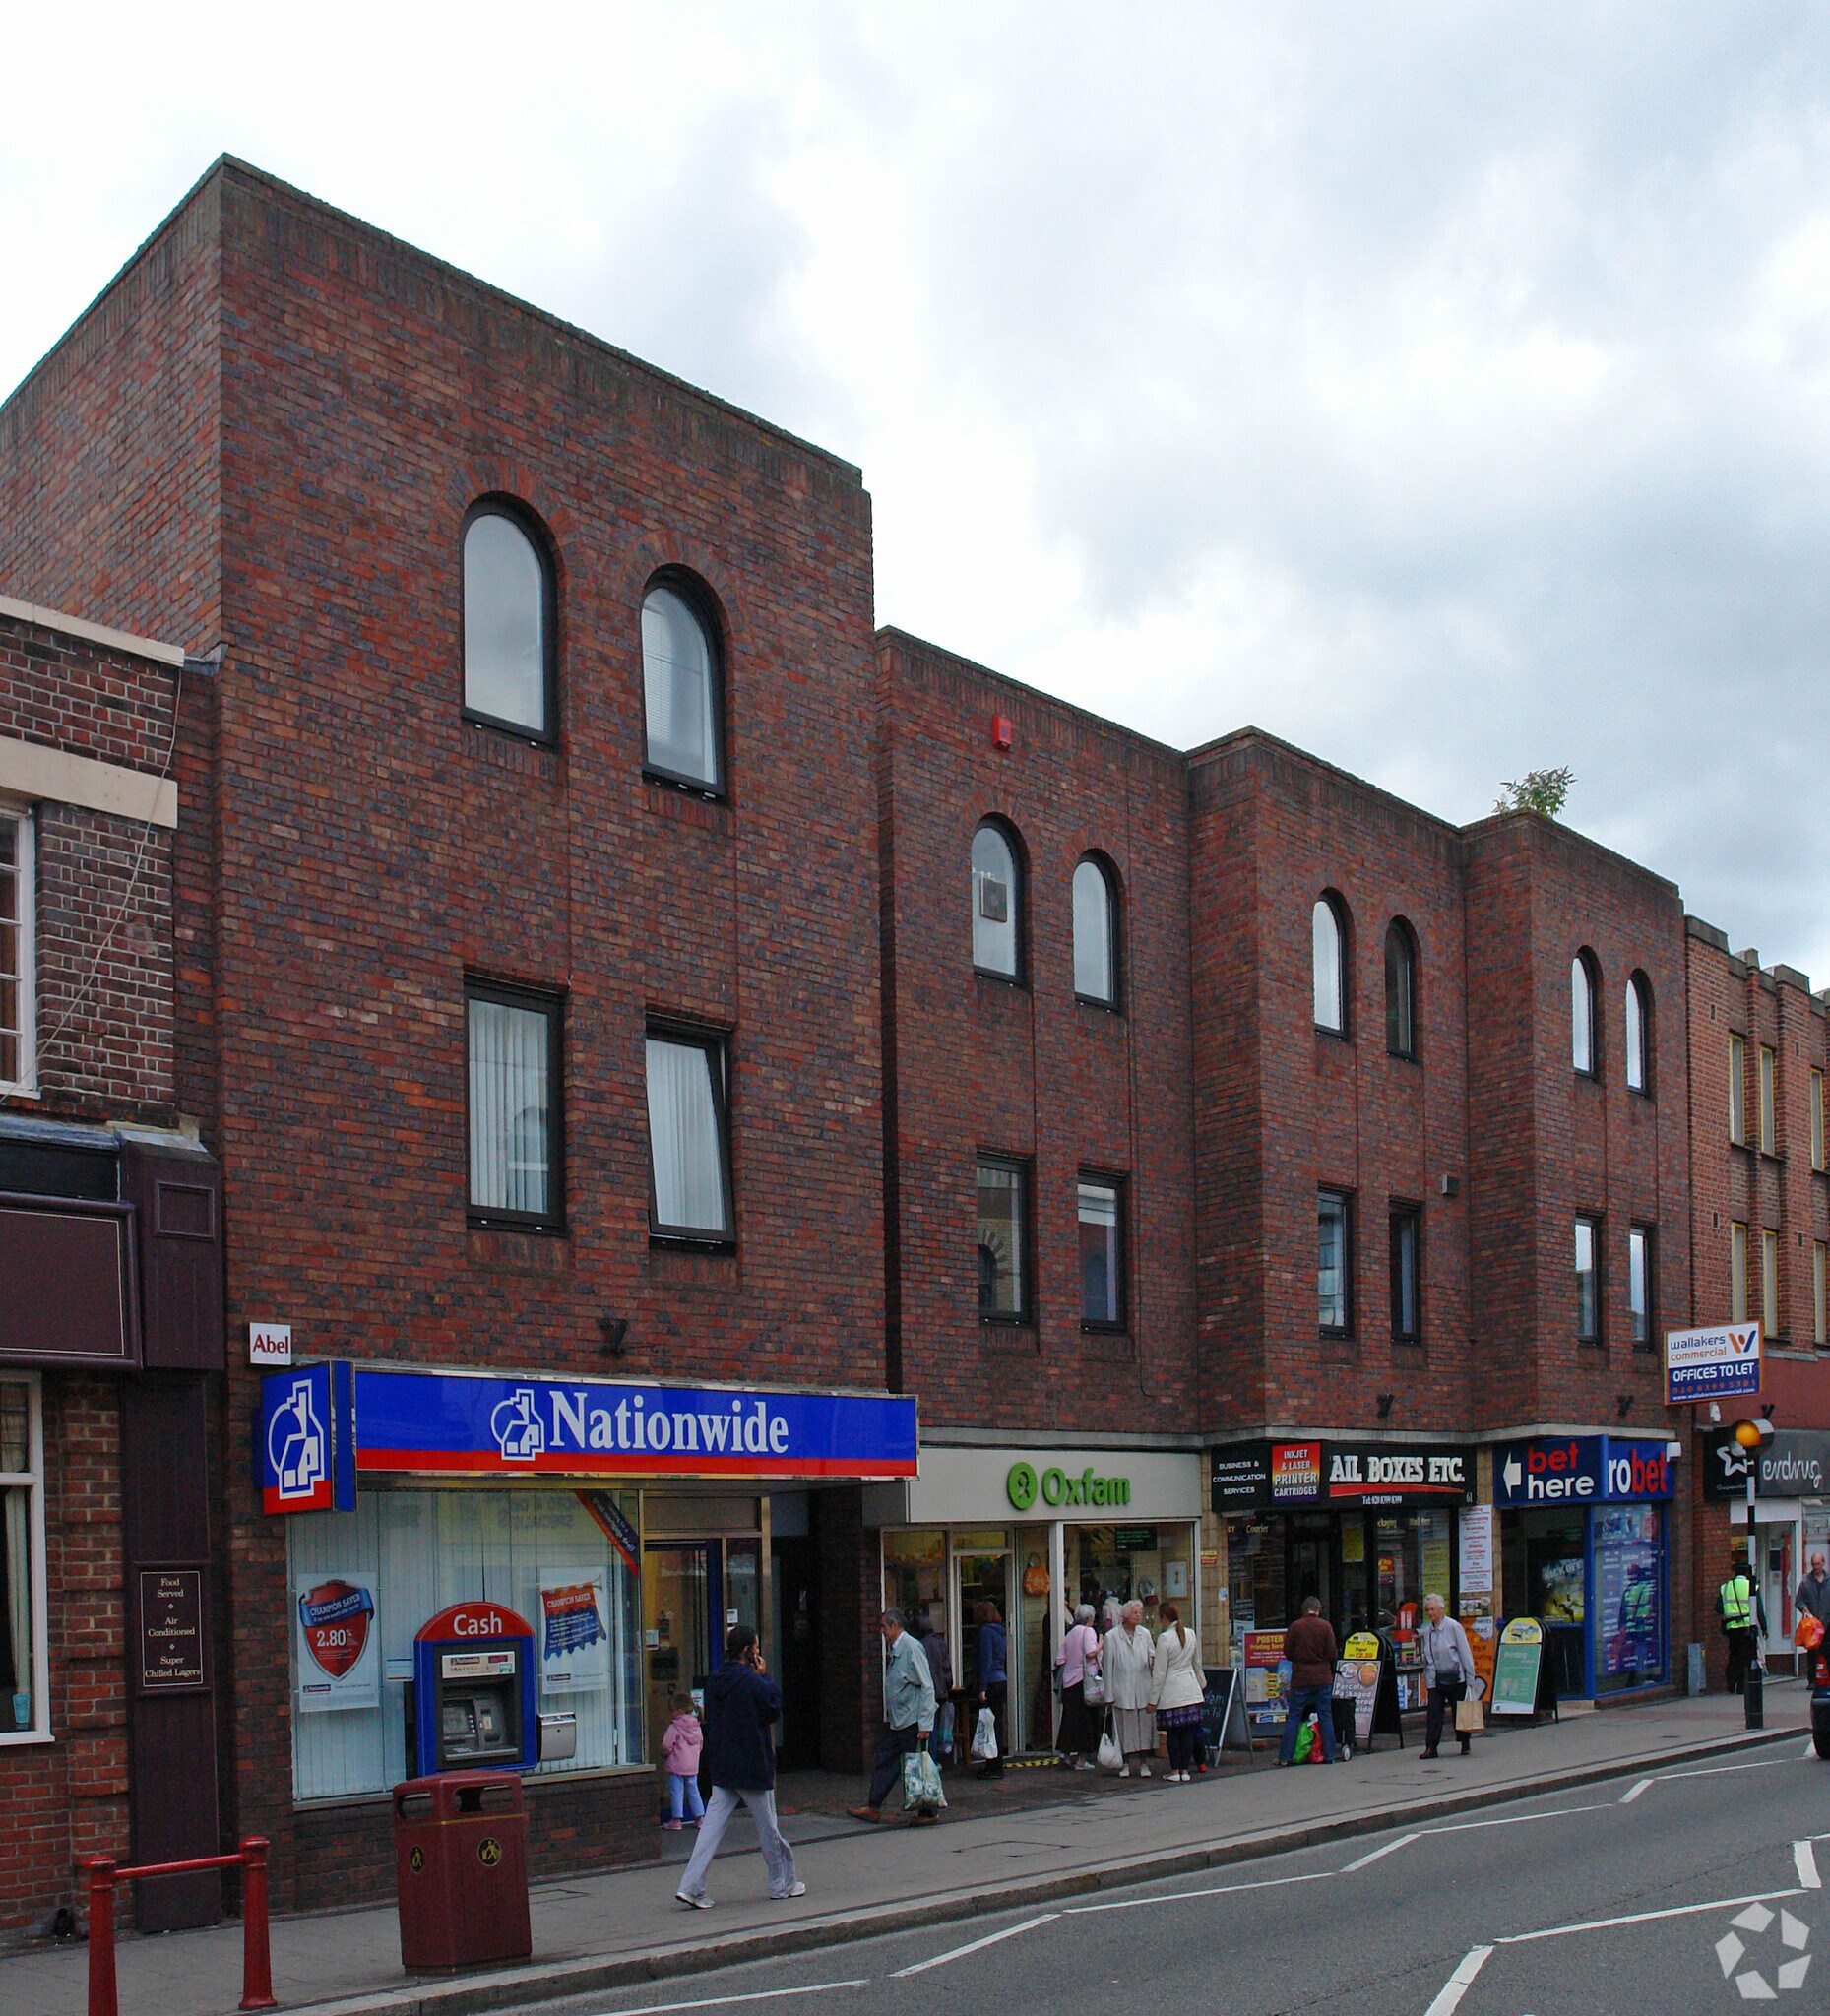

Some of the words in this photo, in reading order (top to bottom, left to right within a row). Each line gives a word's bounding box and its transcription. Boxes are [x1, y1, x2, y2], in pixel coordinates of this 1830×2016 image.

[253, 1333, 289, 1354] Abel
[1671, 1335, 1726, 1350] wallakers
[1671, 1346, 1727, 1361] commercial
[1673, 1365, 1718, 1382] OFFICES
[1719, 1364, 1734, 1378] TO
[1735, 1361, 1755, 1375] LET
[548, 1389, 789, 1454] Nationwide
[1284, 1449, 1308, 1459] INKJET
[1528, 1442, 1579, 1473] bet
[1219, 1461, 1251, 1470] BUSINESS
[1289, 1461, 1311, 1470] LASER
[1367, 1456, 1424, 1483] BOXES
[1428, 1457, 1465, 1483] ETC.
[1213, 1473, 1266, 1483] COMMUNICATION
[1275, 1472, 1317, 1485] PRINTER
[1041, 1466, 1131, 1506] Oxfam
[1223, 1486, 1255, 1495] SERVICES
[1274, 1485, 1317, 1497] CARTRIDGES
[1528, 1474, 1595, 1500] here
[1466, 1492, 1473, 1503] 61
[157, 1589, 184, 1598] Served
[310, 1599, 342, 1616] CHAMPION
[546, 1596, 574, 1608] CHAMPION
[453, 1611, 503, 1636] Cash
[148, 1627, 195, 1637] Conditioned
[160, 1656, 185, 1666] Super
[145, 1670, 172, 1678] Chilled
[175, 1669, 200, 1678] Lagers
